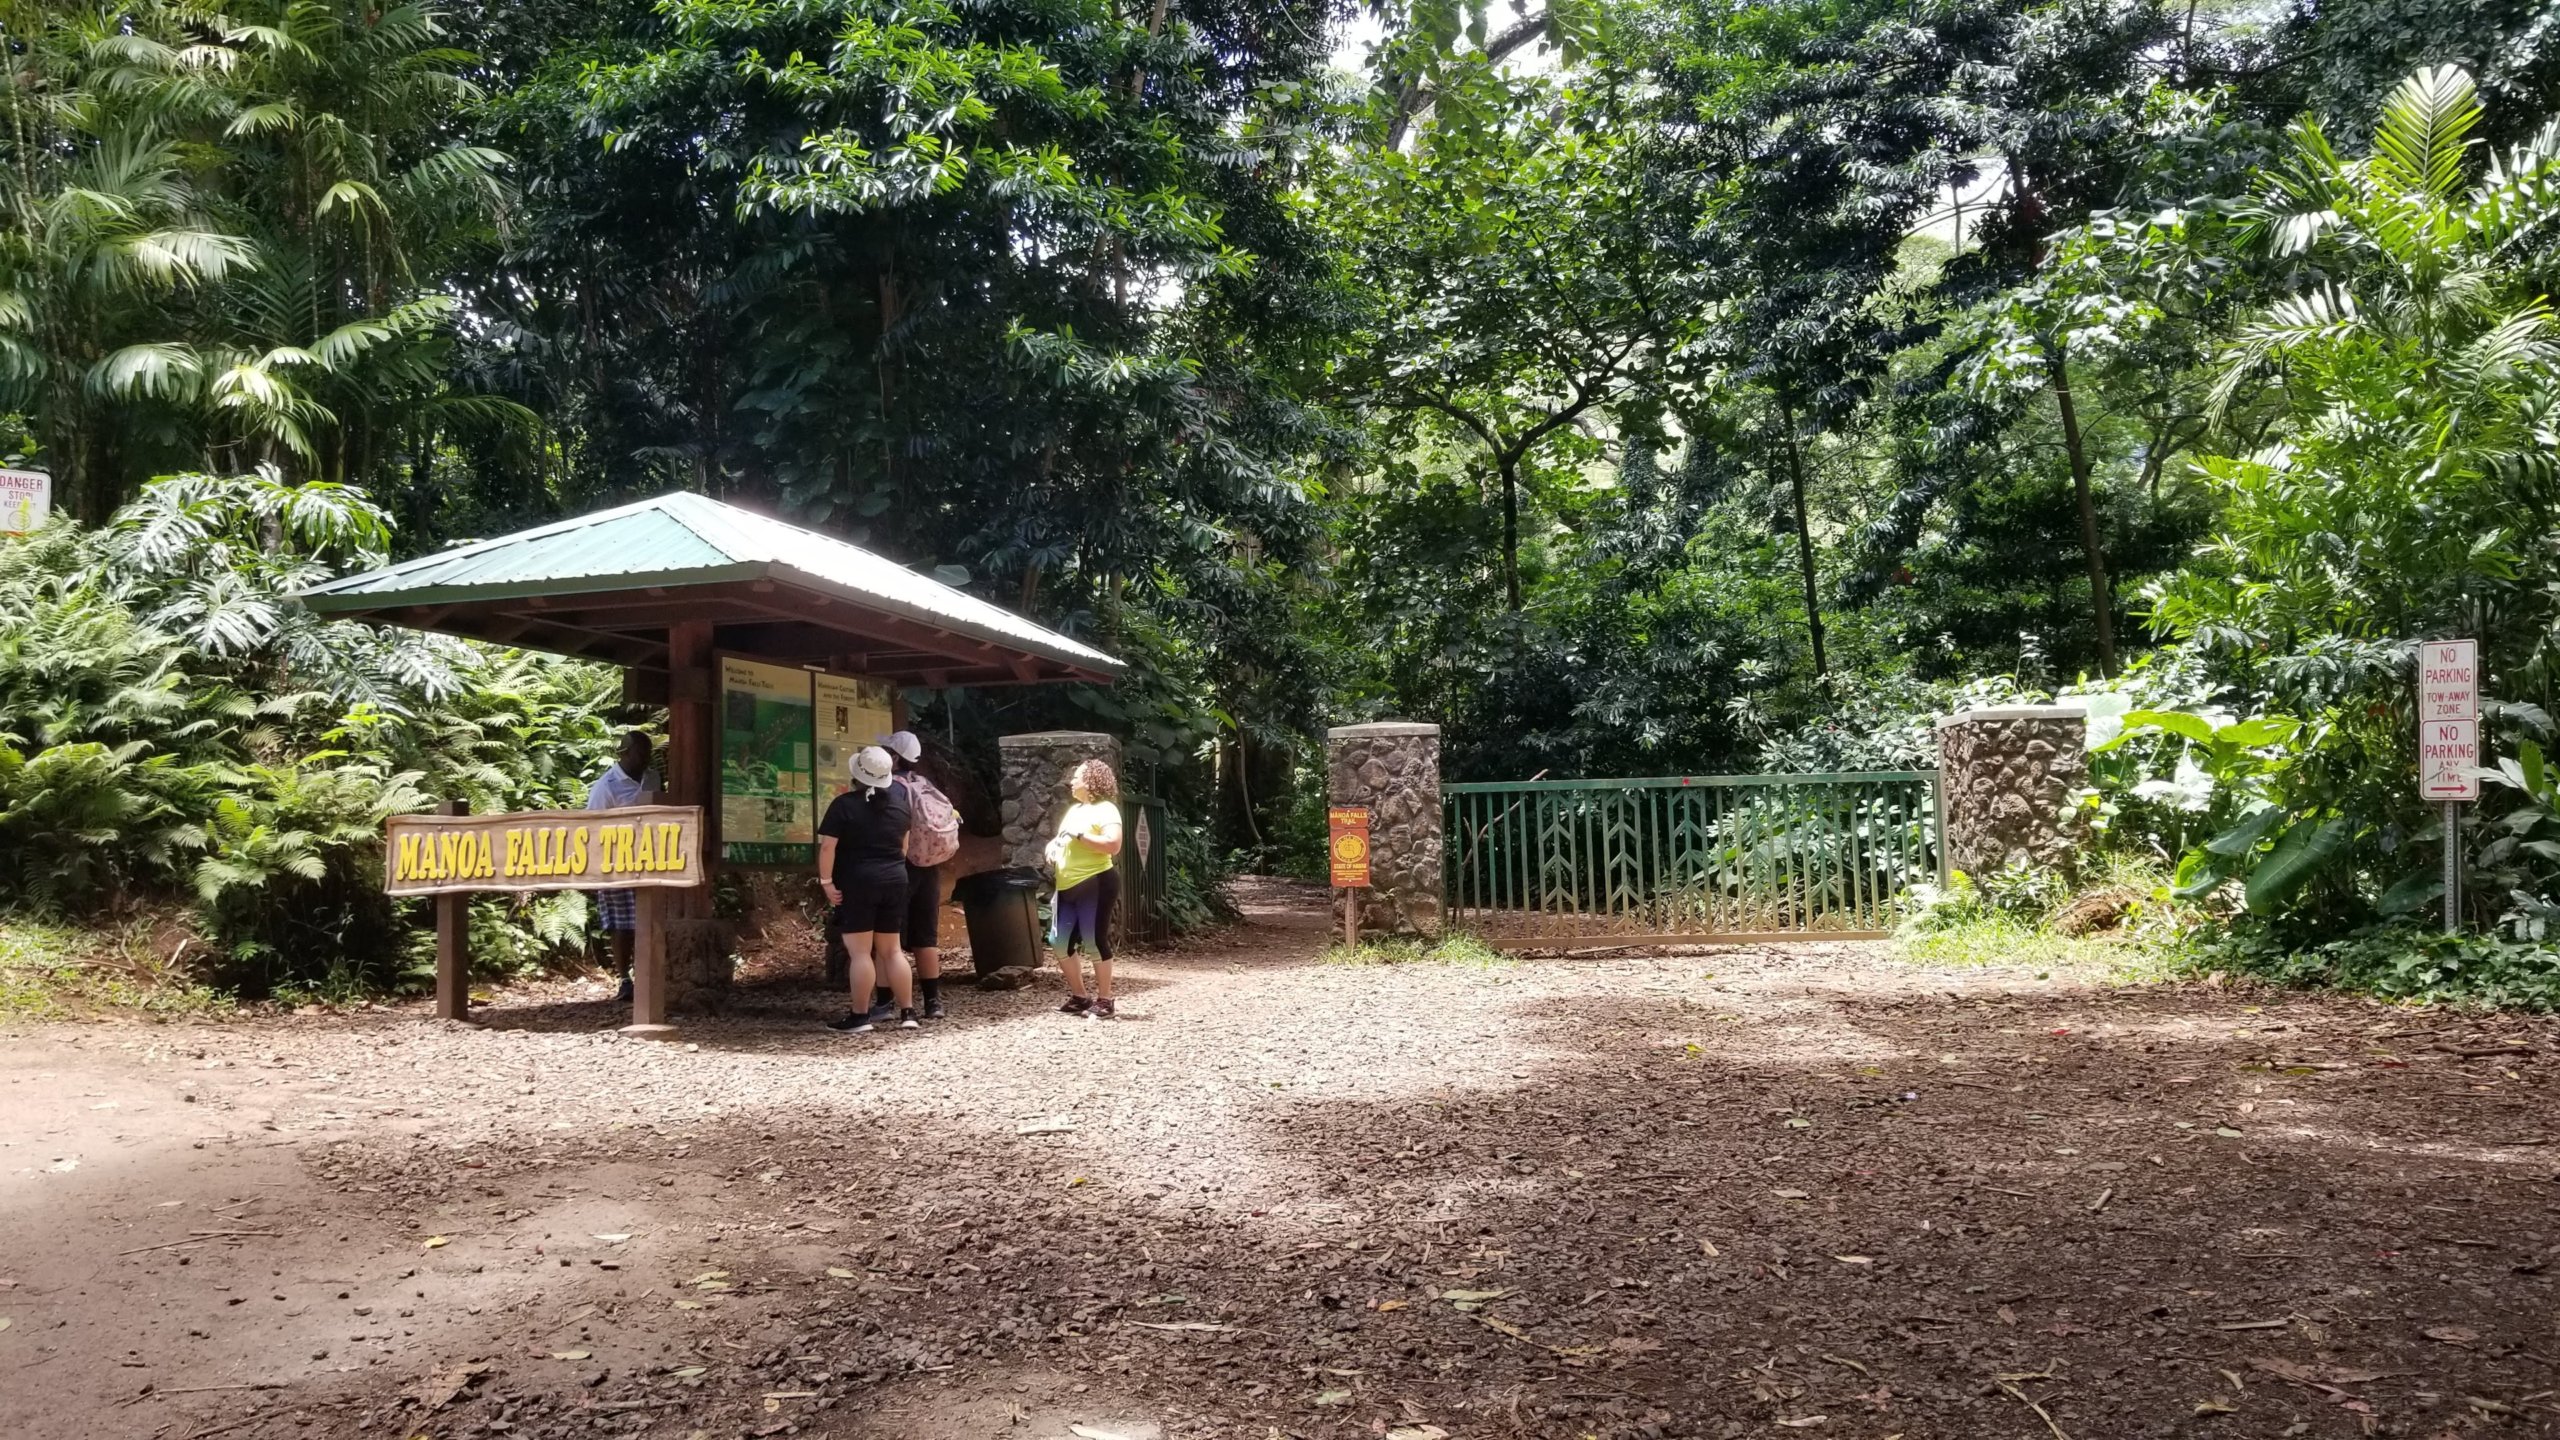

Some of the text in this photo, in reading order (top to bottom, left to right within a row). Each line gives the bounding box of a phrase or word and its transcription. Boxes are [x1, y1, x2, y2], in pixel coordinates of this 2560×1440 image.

[0, 476, 43, 490] DANGER
[2440, 648, 2456, 664] NO
[2425, 668, 2471, 685] PARKING
[2426, 691, 2471, 703] TOW-AWAY
[2437, 704, 2461, 715] ZONE
[2439, 726, 2459, 741] NO
[2425, 743, 2474, 759] PARKING
[2439, 760, 2460, 771] ANY
[2437, 772, 2463, 783] TIME
[396, 822, 686, 880] MANOA FALLS TRAIL
